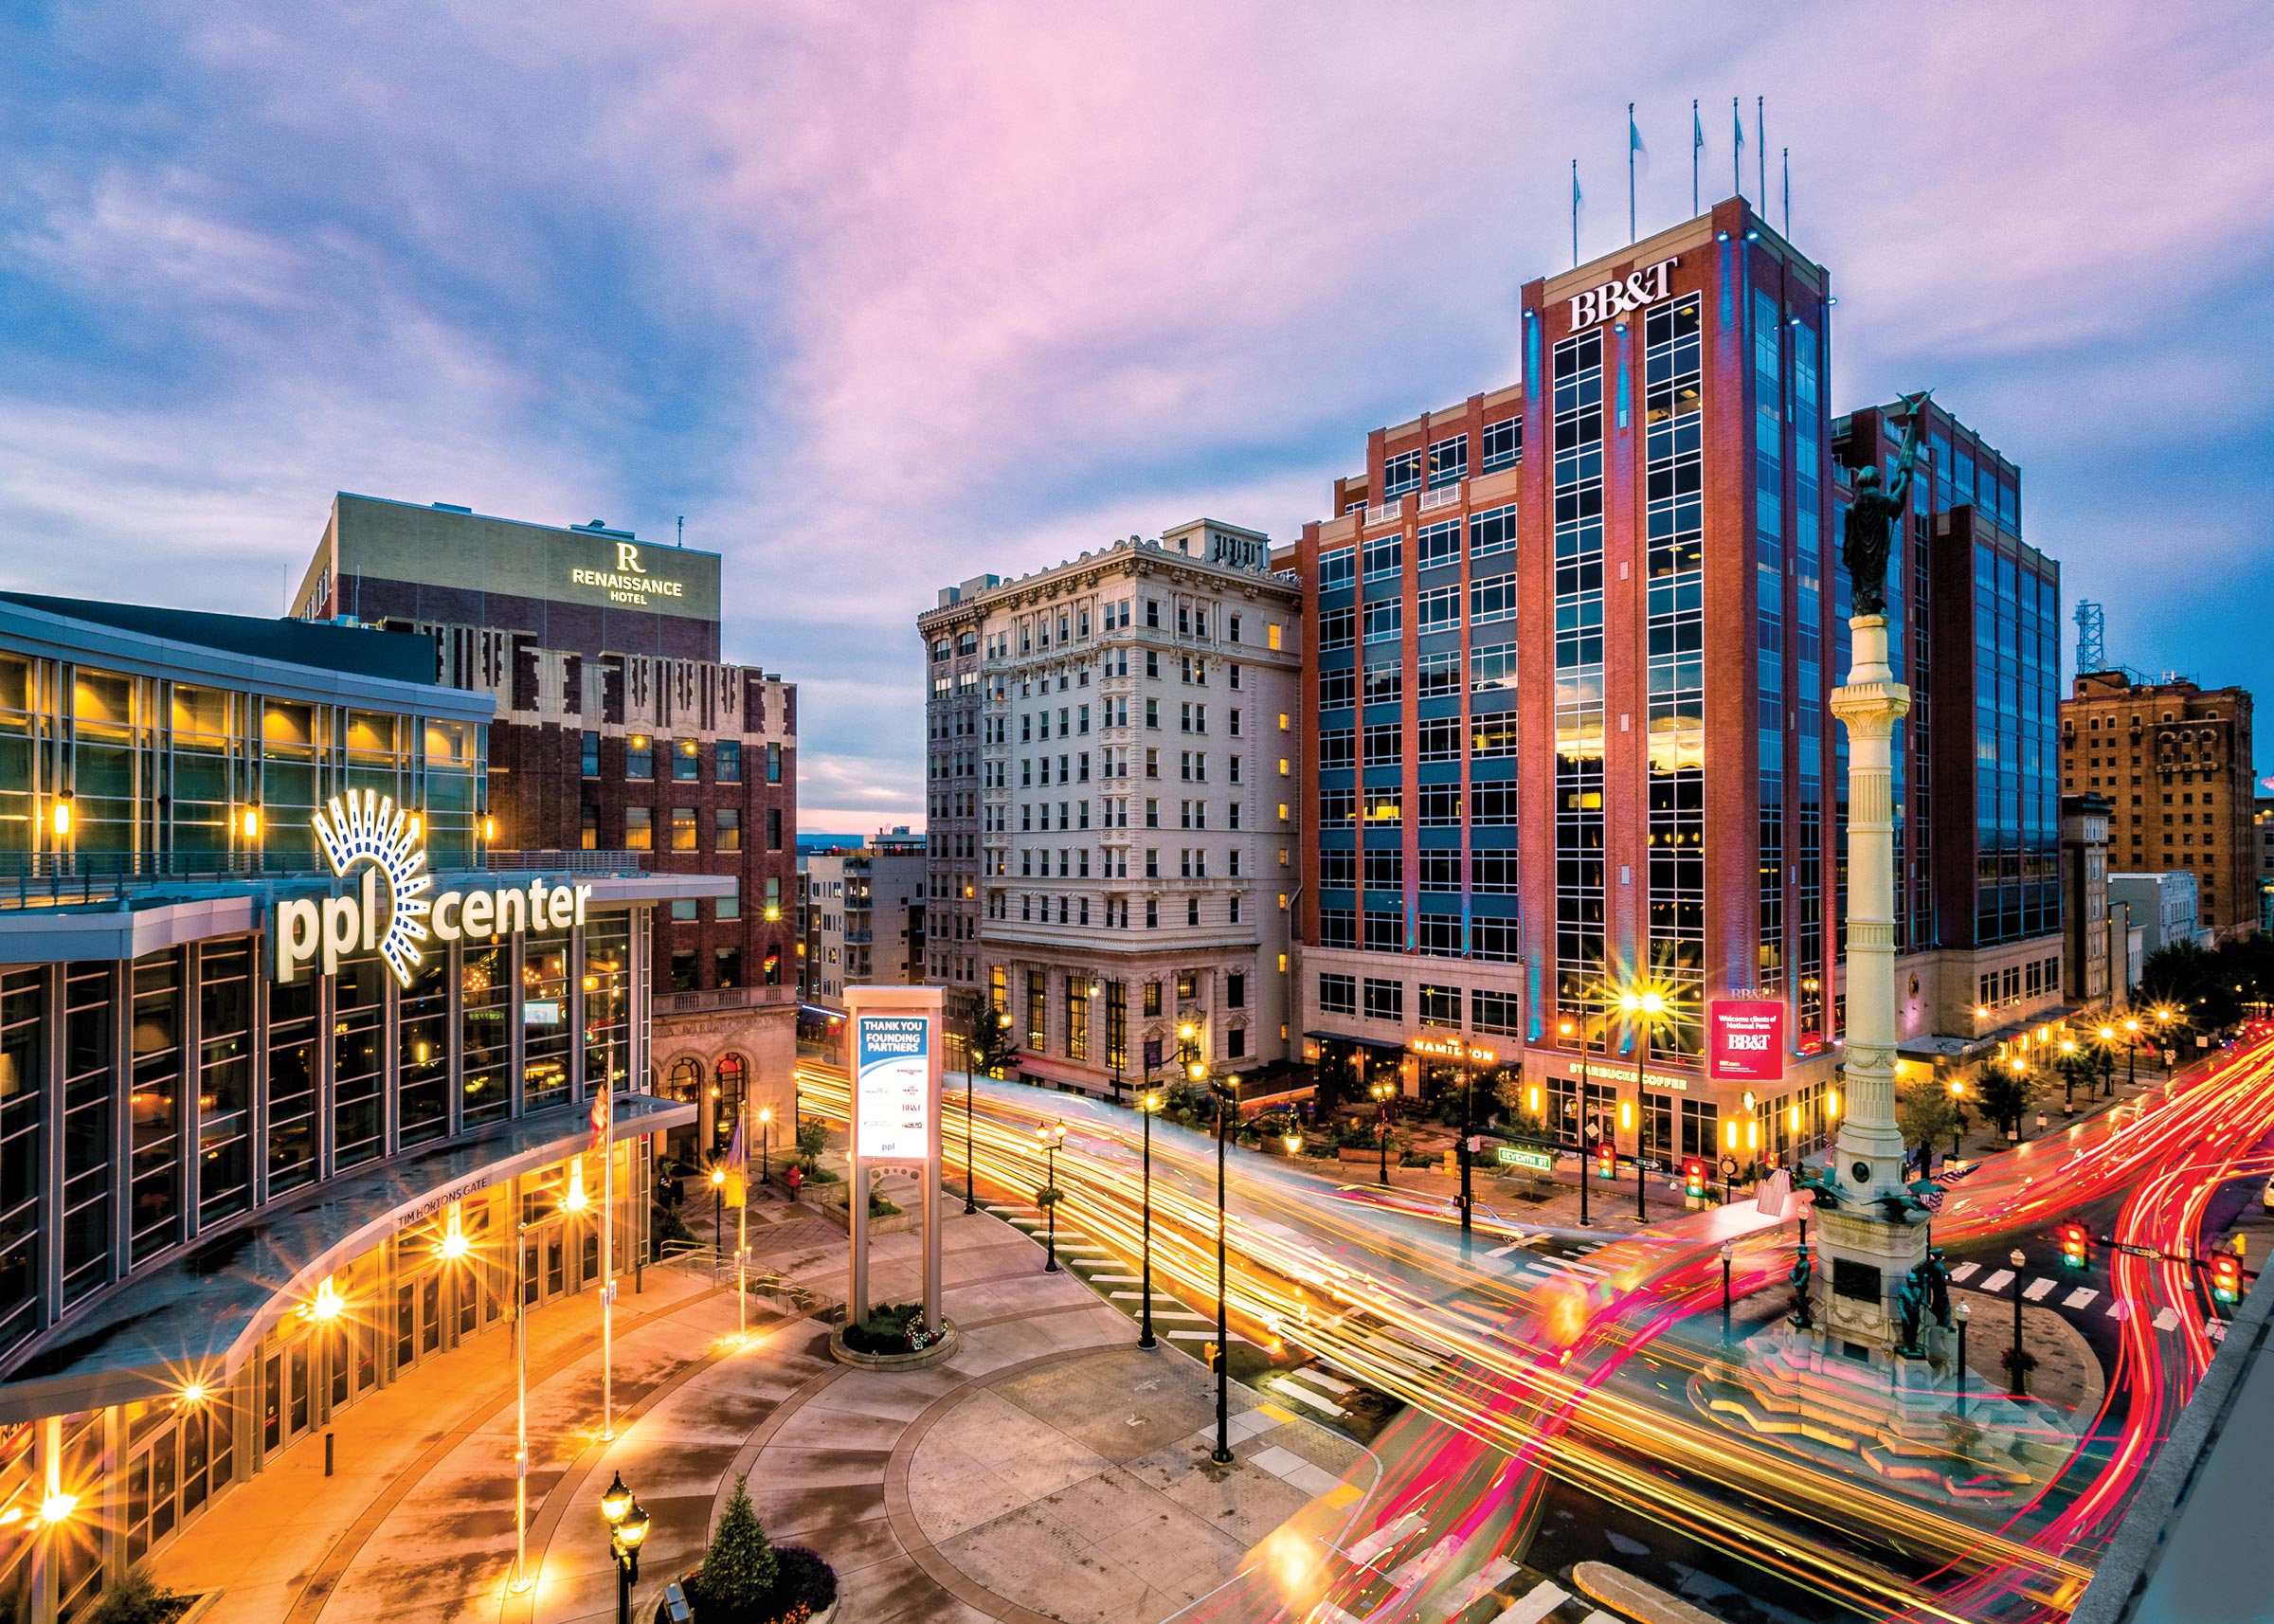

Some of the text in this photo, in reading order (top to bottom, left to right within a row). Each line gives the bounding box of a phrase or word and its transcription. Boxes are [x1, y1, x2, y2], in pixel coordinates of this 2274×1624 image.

[1567, 256, 1679, 333] BB&T
[616, 542, 647, 573] R
[572, 568, 683, 597] RENAISSANCE
[610, 591, 648, 605] HOTEL
[431, 877, 592, 941] center
[276, 865, 376, 983] ppl
[863, 1021, 923, 1031] THANK YOU
[866, 1033, 921, 1042] FOUNDING
[867, 1043, 919, 1052] PARTNERS
[1727, 1034, 1771, 1051] BB&T
[1414, 1040, 1494, 1061] HAMILON
[1569, 1062, 1687, 1091] STARBUCKS COFFEE
[881, 1143, 895, 1151] ppl
[1501, 1150, 1548, 1167] SEVENTH ST
[398, 1177, 488, 1227] TIM HORTONS GATE
